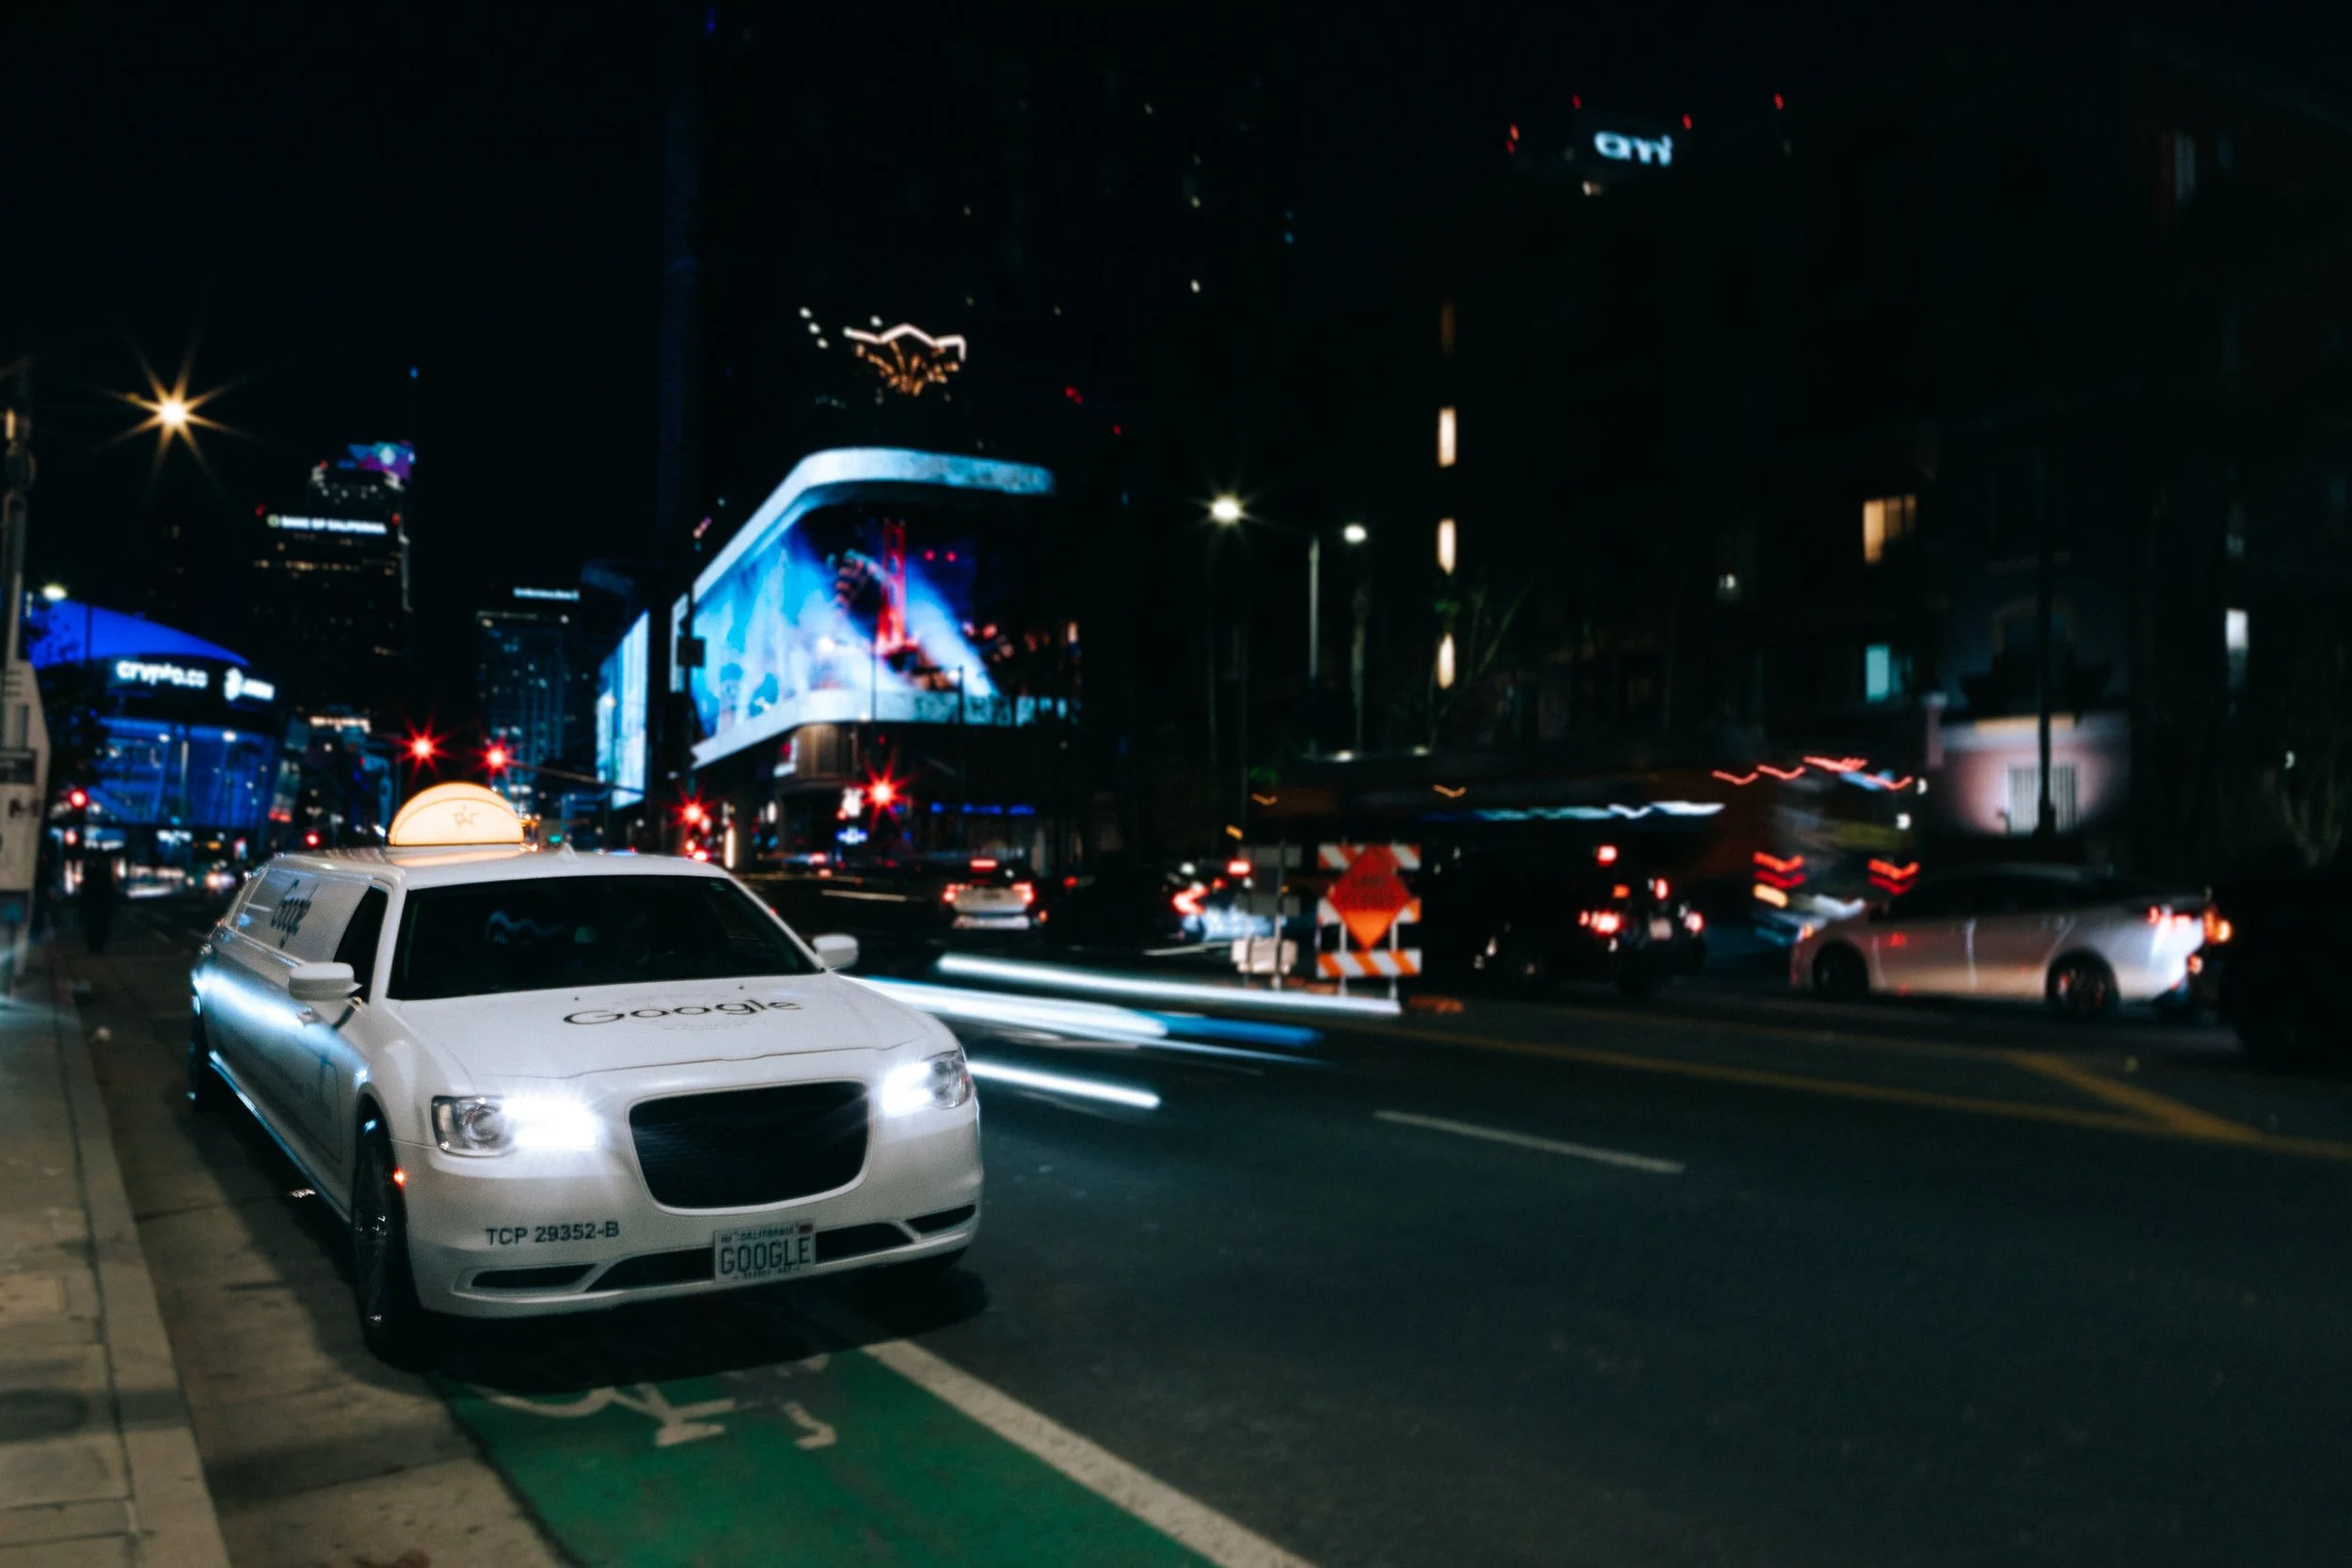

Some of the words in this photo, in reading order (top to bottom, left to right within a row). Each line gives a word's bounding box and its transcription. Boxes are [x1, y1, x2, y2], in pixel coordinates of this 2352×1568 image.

[564, 999, 803, 1024] Google
[485, 1226, 529, 1245] TCP
[533, 1220, 620, 1243] 29352-B
[721, 1236, 812, 1275] GOOGLE
